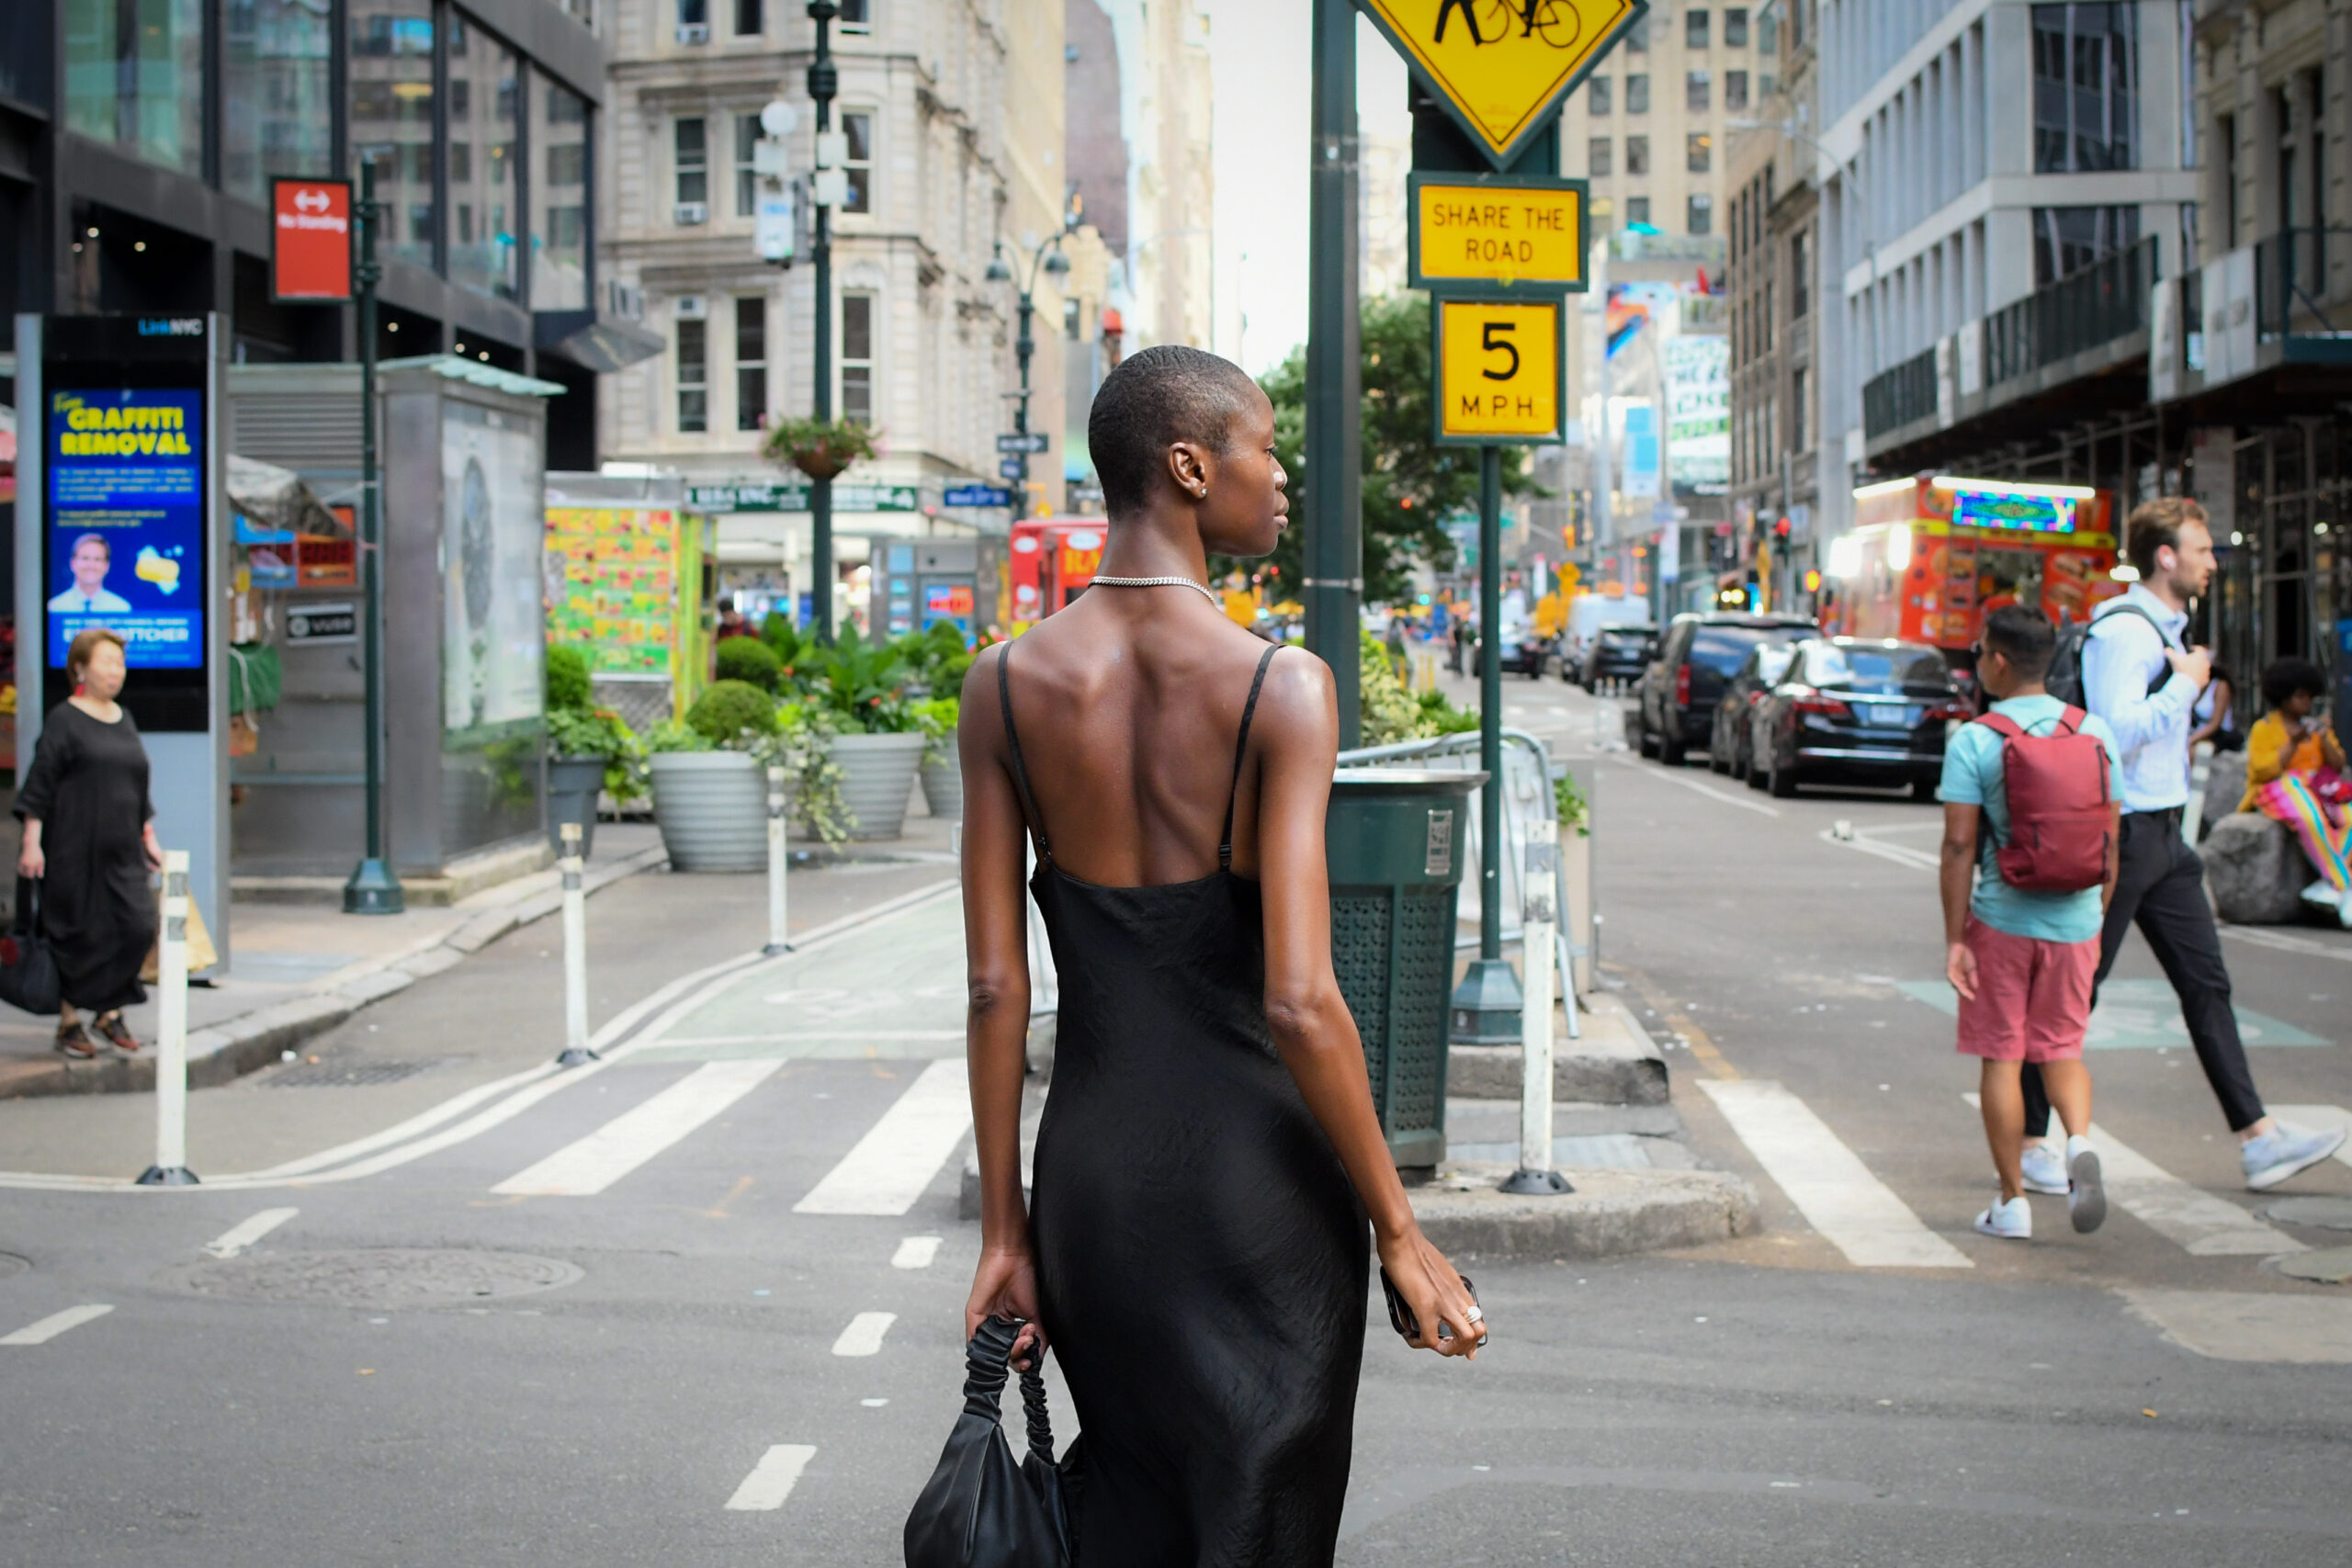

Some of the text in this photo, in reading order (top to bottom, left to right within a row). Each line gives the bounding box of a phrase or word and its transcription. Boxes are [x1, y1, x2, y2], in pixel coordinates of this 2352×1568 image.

[1433, 204, 1565, 231] SHARE THE
[1466, 239, 1532, 263] ROAD
[139, 318, 203, 335] LinkNYC
[1482, 322, 1520, 381] 5
[67, 407, 183, 430] GRAFFITI
[60, 432, 191, 455] REMOVAL
